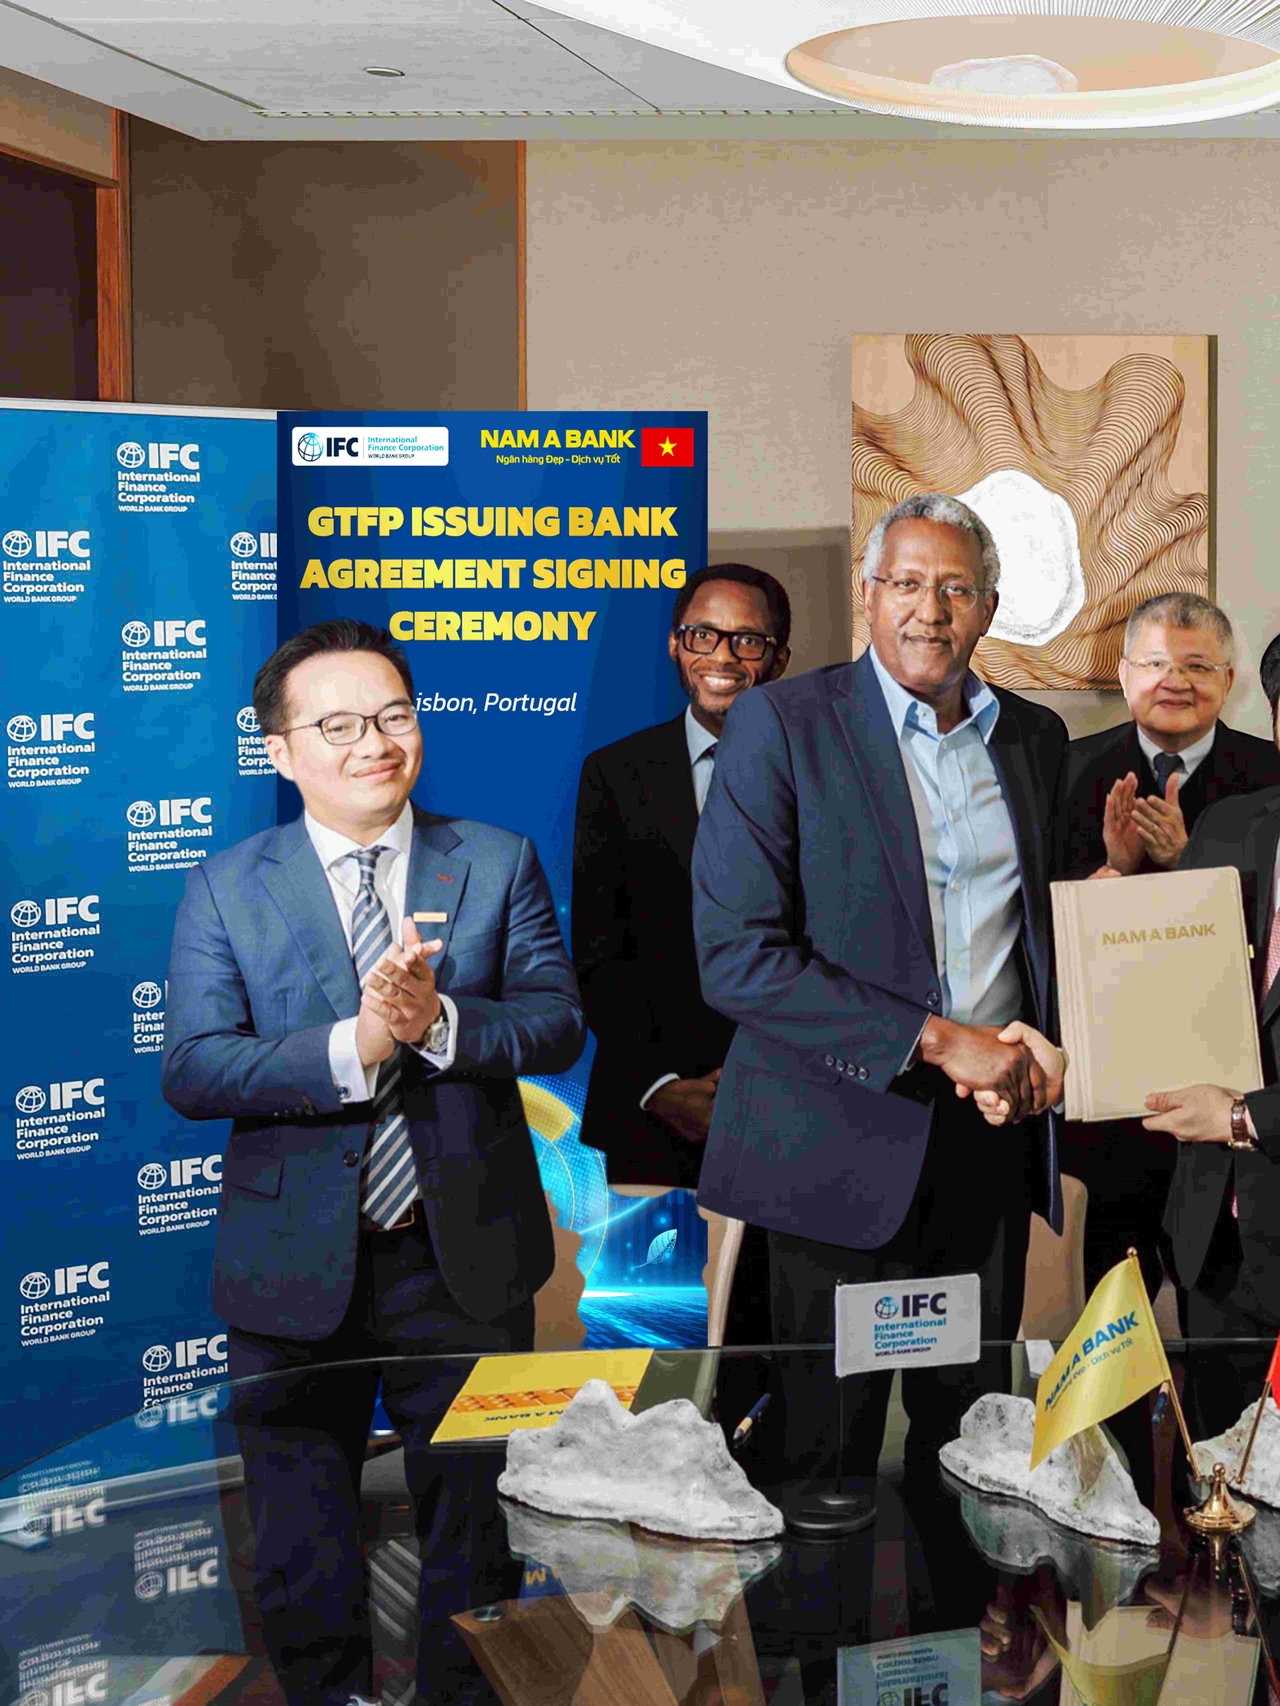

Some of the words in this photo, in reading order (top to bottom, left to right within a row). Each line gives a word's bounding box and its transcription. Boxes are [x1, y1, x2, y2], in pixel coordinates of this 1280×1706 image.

[327, 437, 359, 457] IFC
[481, 430, 539, 448] NAM
[543, 430, 561, 448] A
[565, 430, 636, 448] BANK
[149, 443, 200, 469] IFC
[398, 444, 444, 452] Corporation
[496, 455, 520, 465] Ngân
[522, 454, 544, 465] hàng
[546, 455, 564, 465] Đẹp
[572, 455, 591, 465] Dịch
[593, 457, 604, 465] vụ
[605, 453, 620, 463] Tốt
[118, 471, 200, 482] International
[118, 481, 167, 492] Finance
[117, 491, 195, 505] Corporation
[307, 507, 404, 537] GTFP
[411, 507, 561, 537] ISSUING
[569, 507, 678, 537] BANK
[36, 531, 90, 557] IFC
[3, 560, 90, 570] International
[3, 571, 54, 581] Finance
[232, 571, 276, 581] Finance
[300, 559, 526, 589] AGREEMENT
[533, 559, 686, 589] SIGNING
[3, 582, 84, 595] Corporation
[154, 620, 206, 647] IFC
[389, 611, 597, 641] CEREMONY
[122, 648, 207, 660] International
[122, 660, 172, 671] Finance
[122, 670, 201, 683] Corporation
[416, 693, 477, 714] isbon,
[484, 693, 577, 716] Portugal
[40, 713, 95, 741] IFC
[7, 743, 95, 756] International
[7, 754, 59, 767] Finance
[7, 764, 89, 779] Corporation
[160, 798, 212, 825] IFC
[128, 826, 212, 841] International
[128, 838, 178, 852] Finance
[128, 847, 207, 862] Corporation
[45, 895, 100, 925] IFC
[11, 925, 100, 942] International
[1103, 929, 1146, 945] NAM
[1150, 928, 1162, 941] A
[1165, 924, 1216, 940] BANK
[12, 938, 63, 953] Finance
[12, 947, 94, 964] Corporation
[12, 964, 40, 974] WORLD
[41, 963, 60, 971] BANK
[60, 961, 86, 970] GROUP
[50, 1078, 105, 1110] IFC
[16, 1107, 105, 1128] International
[16, 1122, 68, 1139] Finance
[16, 1130, 99, 1150] Corporation
[170, 1155, 222, 1187] IFC
[138, 1184, 222, 1204] International
[138, 1198, 188, 1215] Finance
[138, 1205, 217, 1226] Corporation
[55, 1262, 110, 1296] IFC
[21, 1291, 110, 1315] International
[902, 1292, 947, 1318] IFC
[21, 1307, 73, 1326] Finance
[21, 1313, 103, 1337] Corporation
[874, 1318, 946, 1331] International
[21, 1335, 50, 1347] WORLD
[50, 1332, 69, 1342] BANK
[70, 1328, 96, 1339] GROUP
[875, 1331, 914, 1340] Finance
[875, 1336, 937, 1349] Corporation
[1082, 1311, 1139, 1357] BANK
[175, 1334, 227, 1368] IFC
[143, 1363, 228, 1386] International
[144, 1382, 193, 1397] Finance
